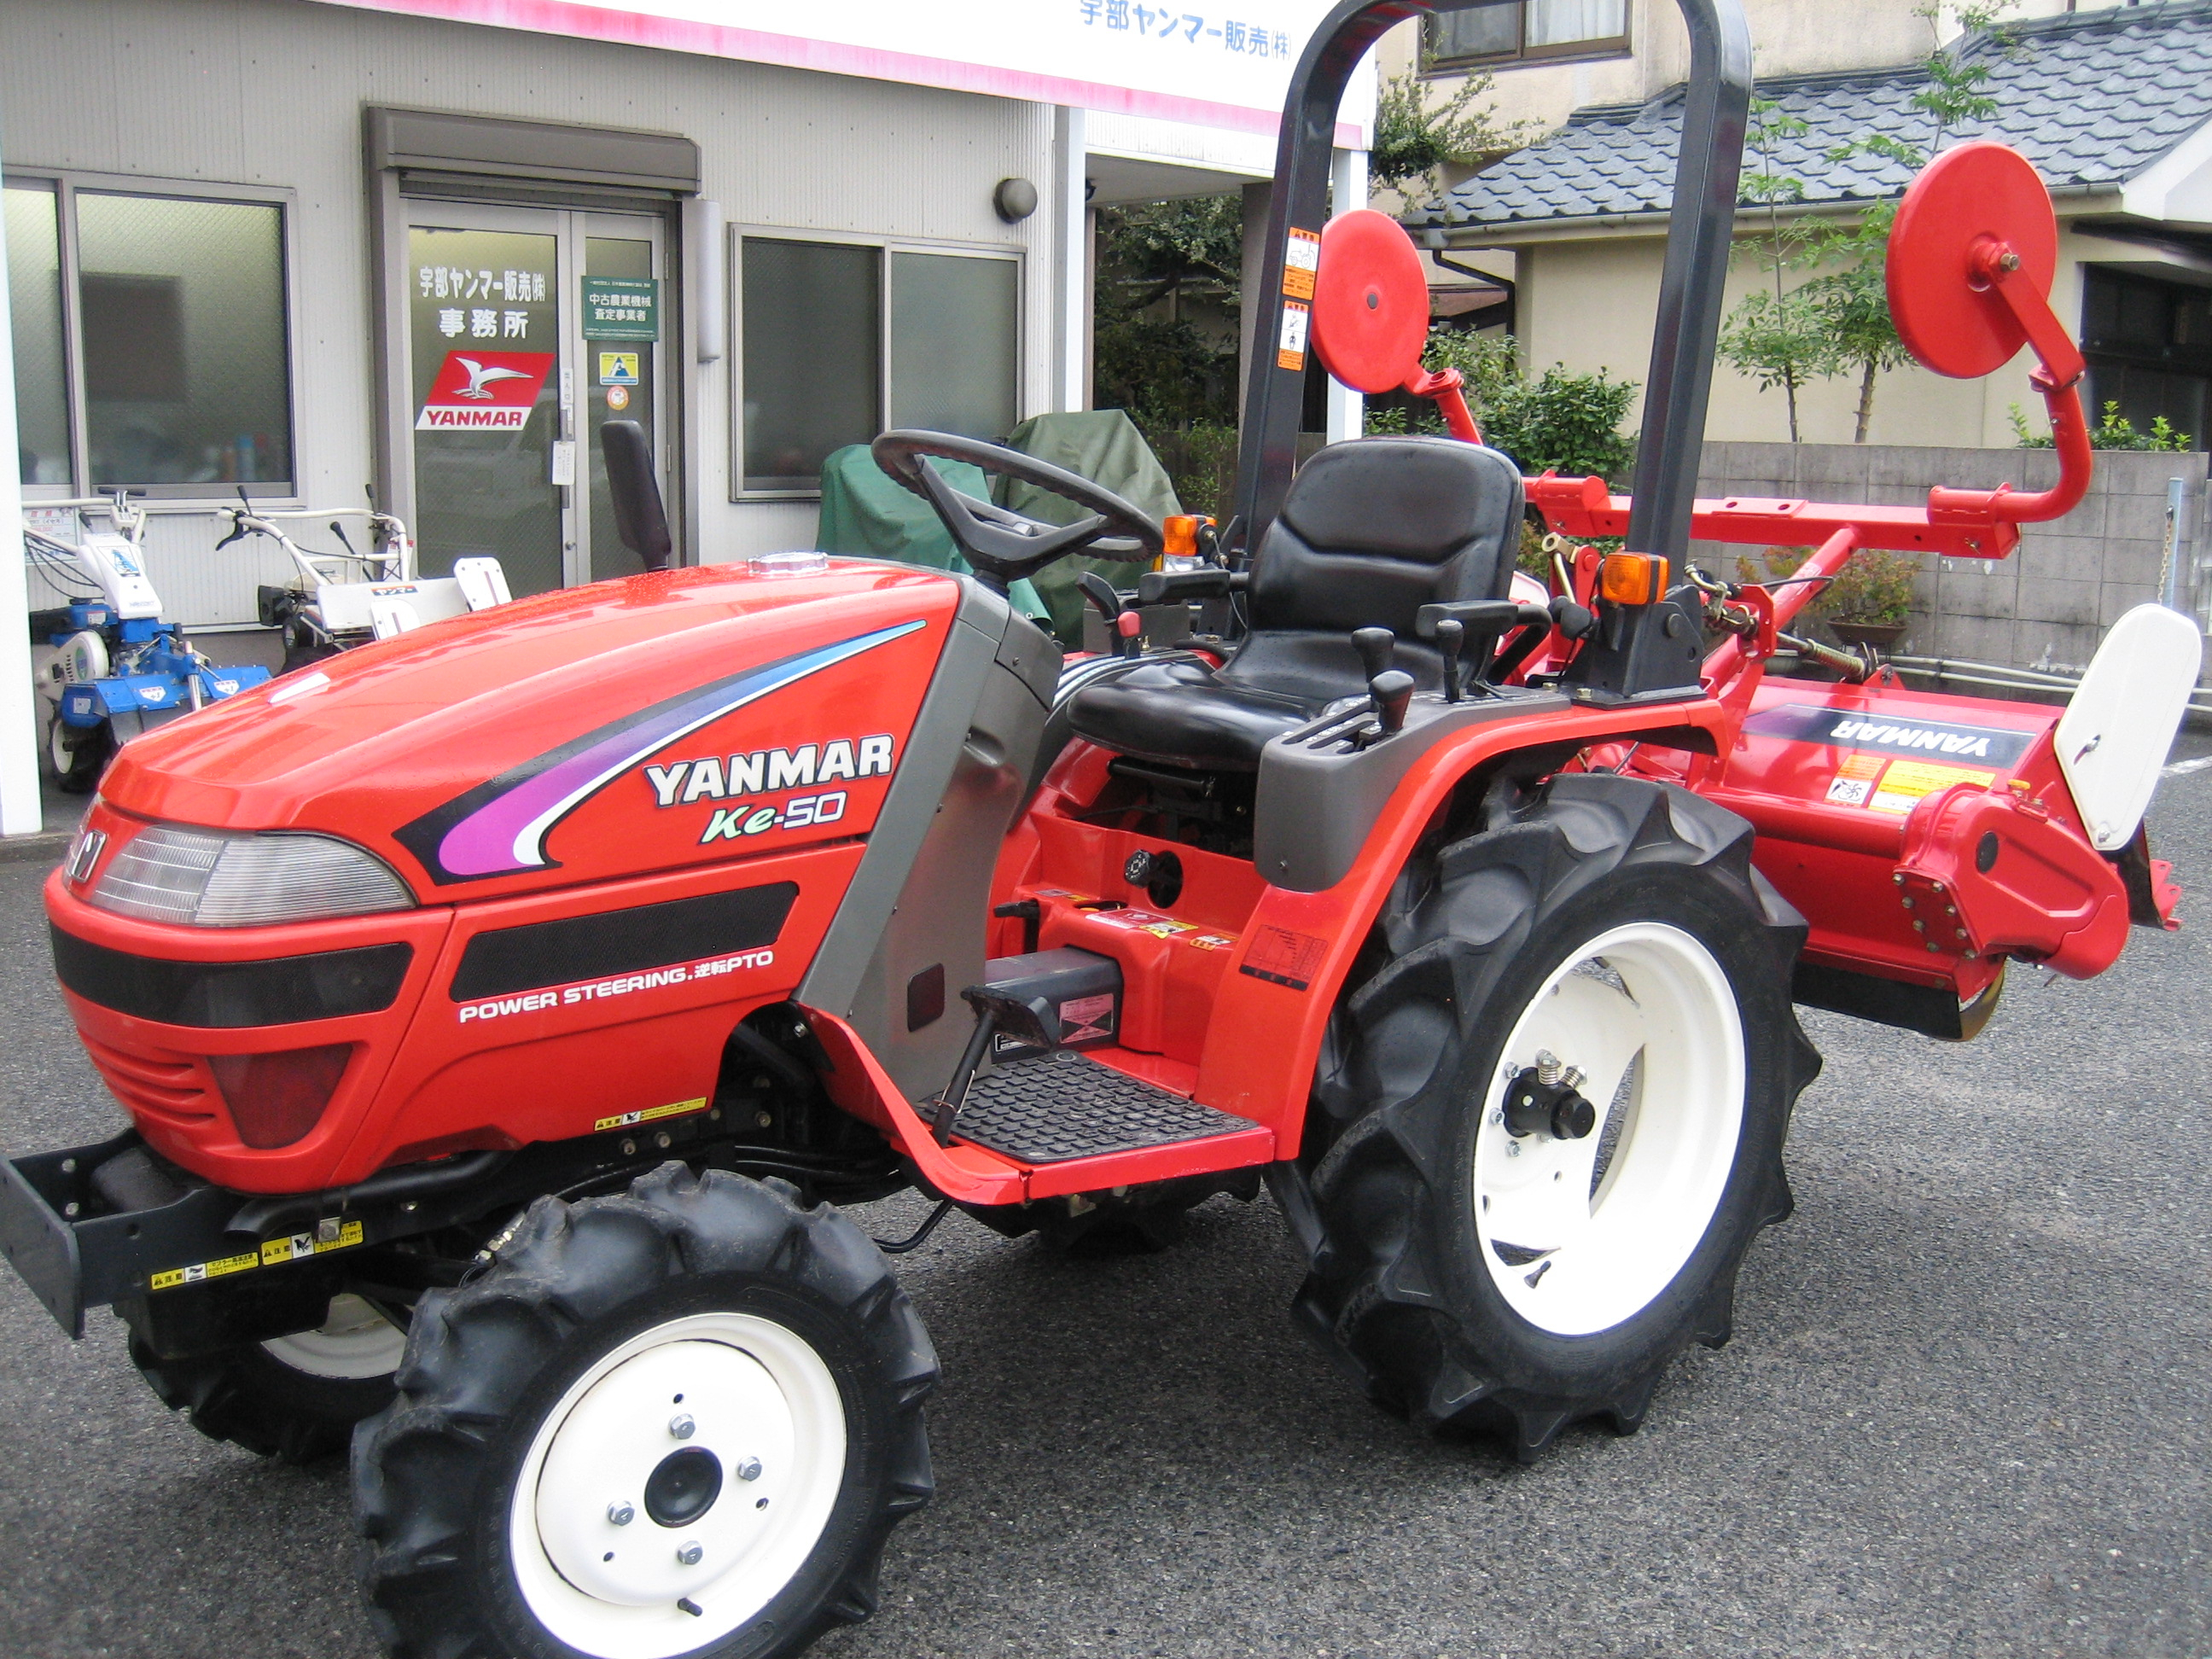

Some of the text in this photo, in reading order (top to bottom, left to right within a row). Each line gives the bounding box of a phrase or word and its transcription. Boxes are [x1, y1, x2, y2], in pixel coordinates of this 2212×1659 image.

[589, 293, 652, 308] 中古農業機械
[595, 308, 647, 323] 査定事業者
[439, 307, 529, 339] 事務所
[427, 410, 523, 427] YANMAR
[1830, 720, 1991, 757] YANMAR
[643, 734, 895, 806] YANMAR
[698, 790, 847, 845] Ke-50
[459, 992, 558, 1023] POWER
